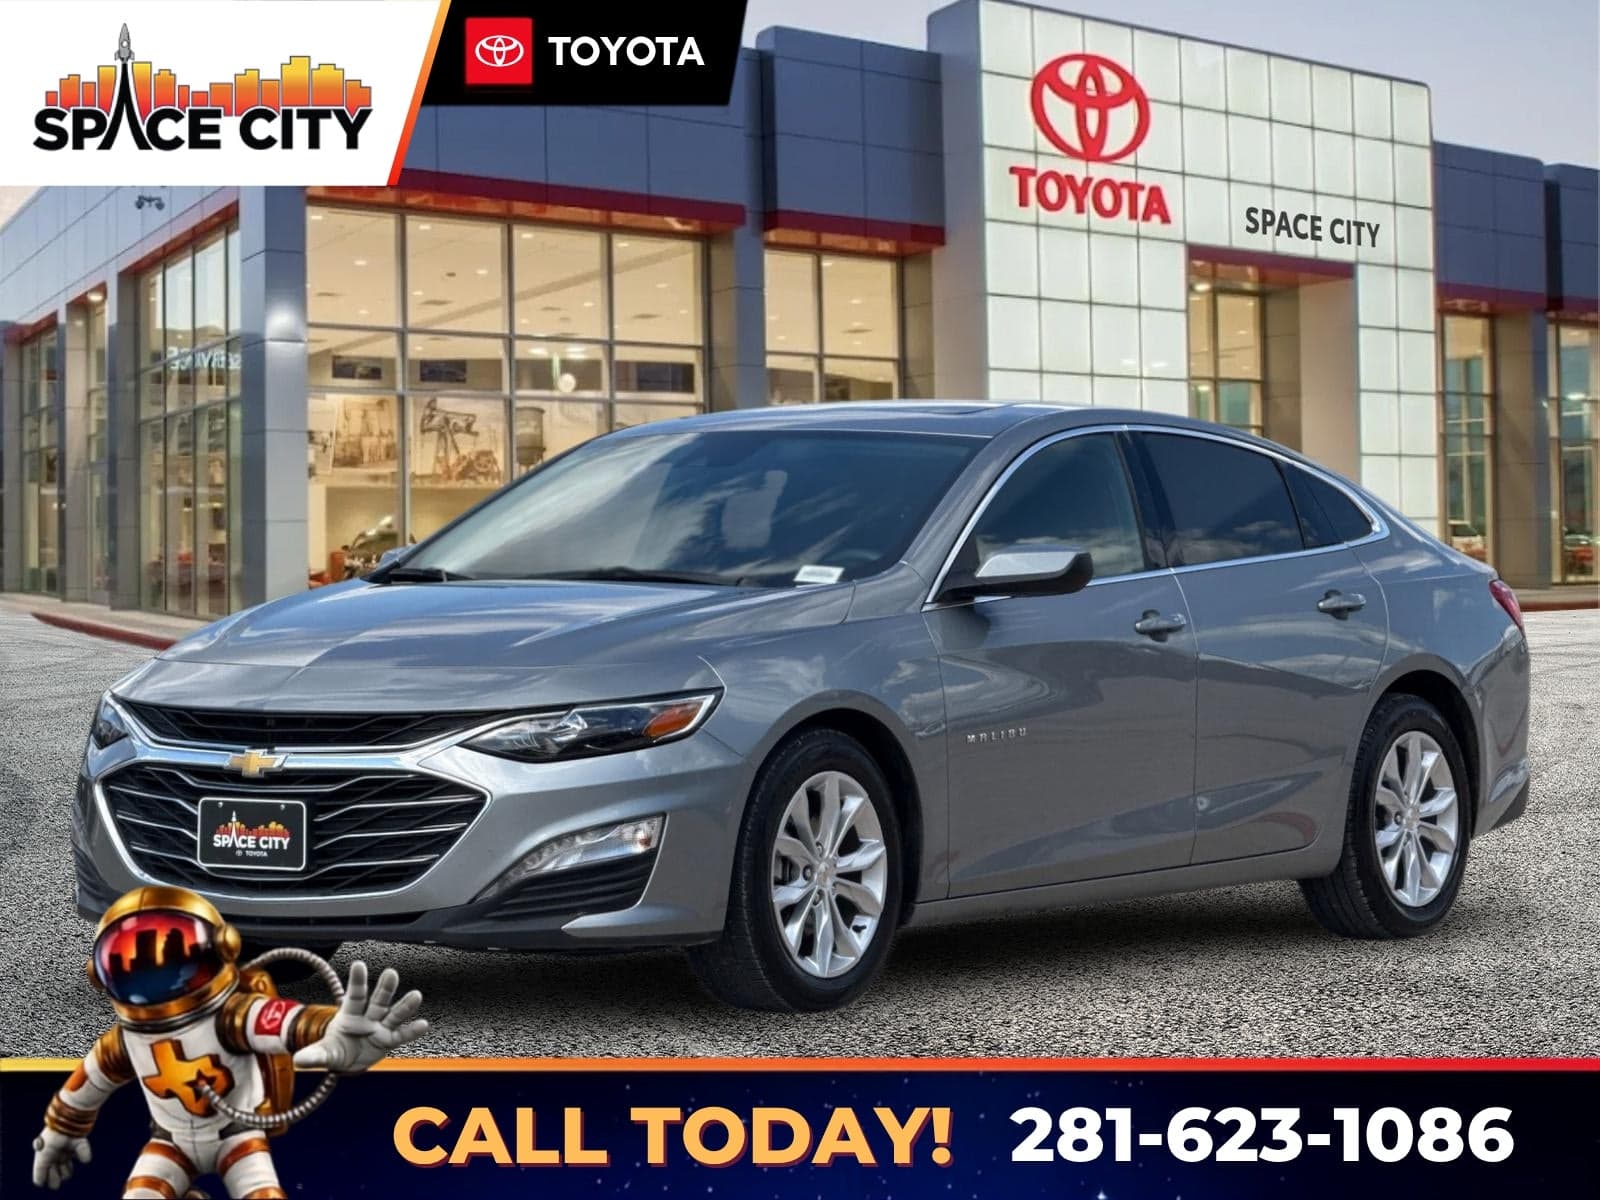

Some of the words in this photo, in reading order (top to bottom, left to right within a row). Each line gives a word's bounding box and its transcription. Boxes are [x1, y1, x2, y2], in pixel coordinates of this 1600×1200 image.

[1009, 165, 1171, 224] TOYOTA
[1245, 206, 1323, 242] SPACE
[1329, 217, 1381, 248] CITY
[966, 727, 1027, 743] MALIBU
[213, 828, 257, 848] SPACE
[260, 836, 290, 850] CITY
